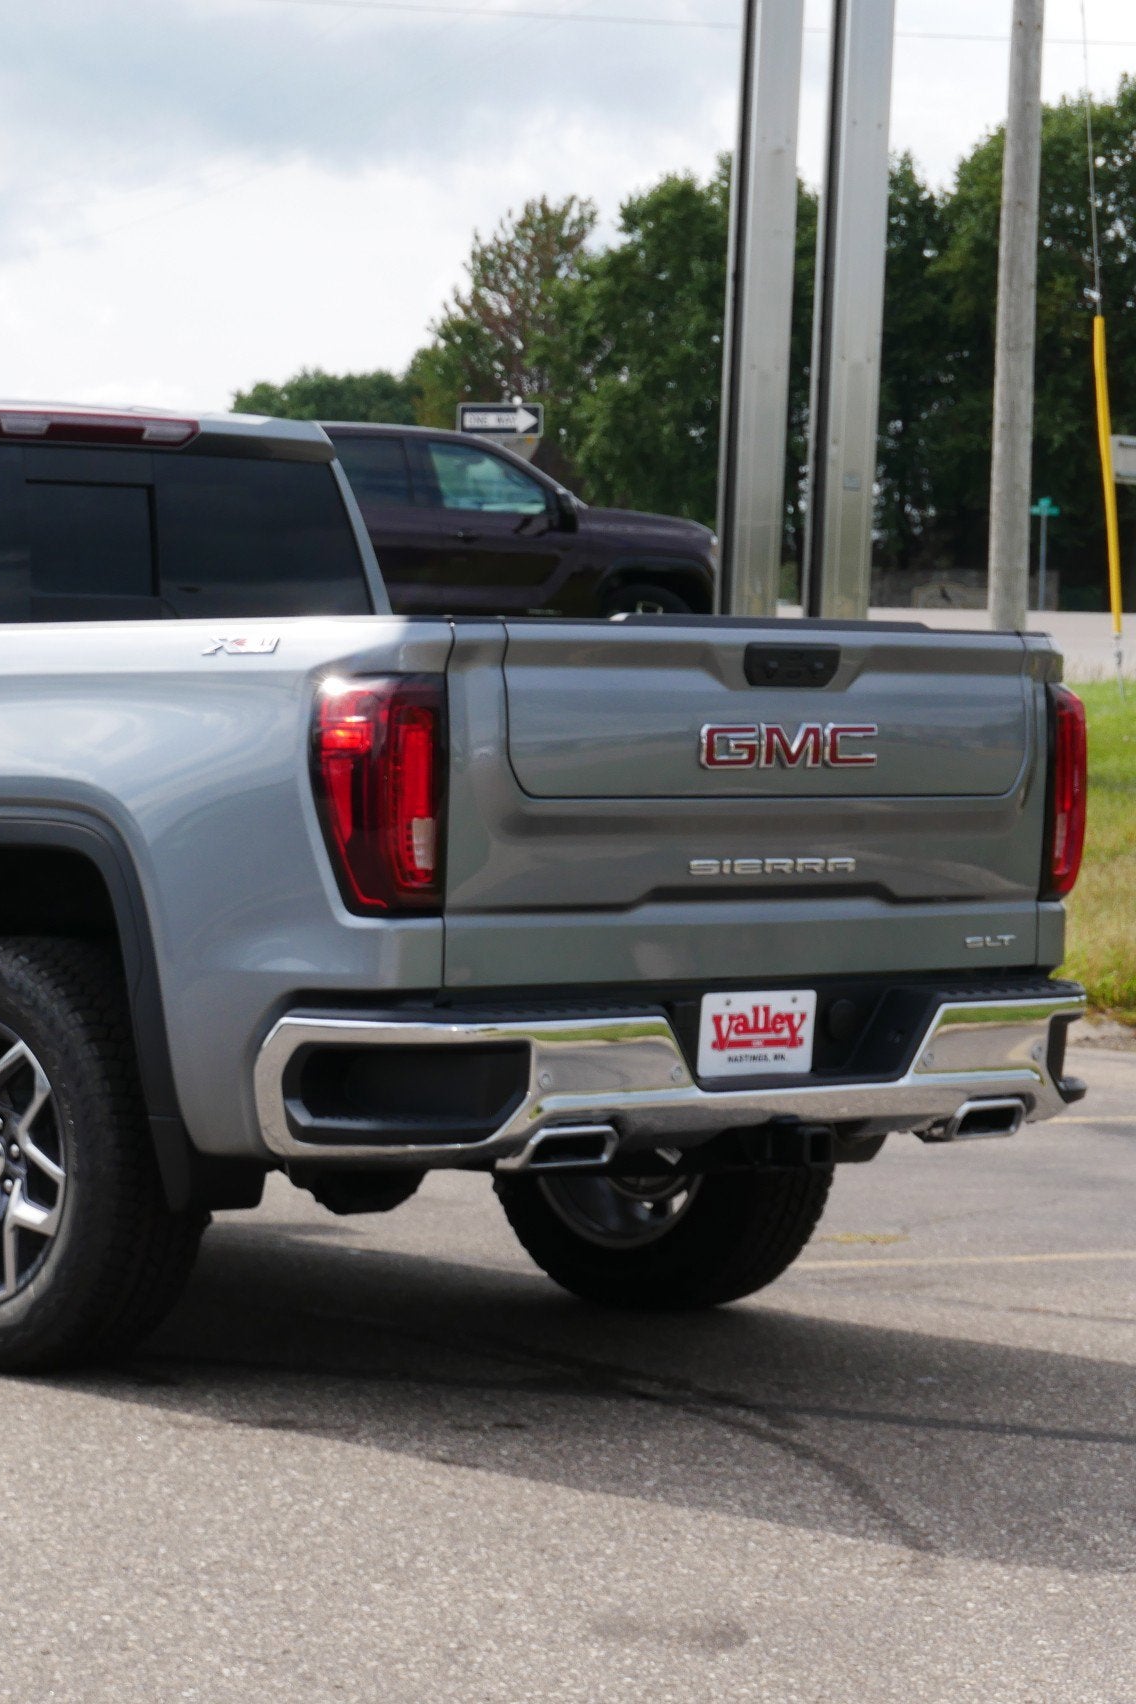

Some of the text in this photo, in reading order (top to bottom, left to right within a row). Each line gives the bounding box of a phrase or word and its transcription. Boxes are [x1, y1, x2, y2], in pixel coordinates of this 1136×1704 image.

[700, 722, 878, 769] GMC
[689, 857, 857, 876] SIERRA
[965, 934, 1017, 949] SLT
[711, 1004, 807, 1051] Valley
